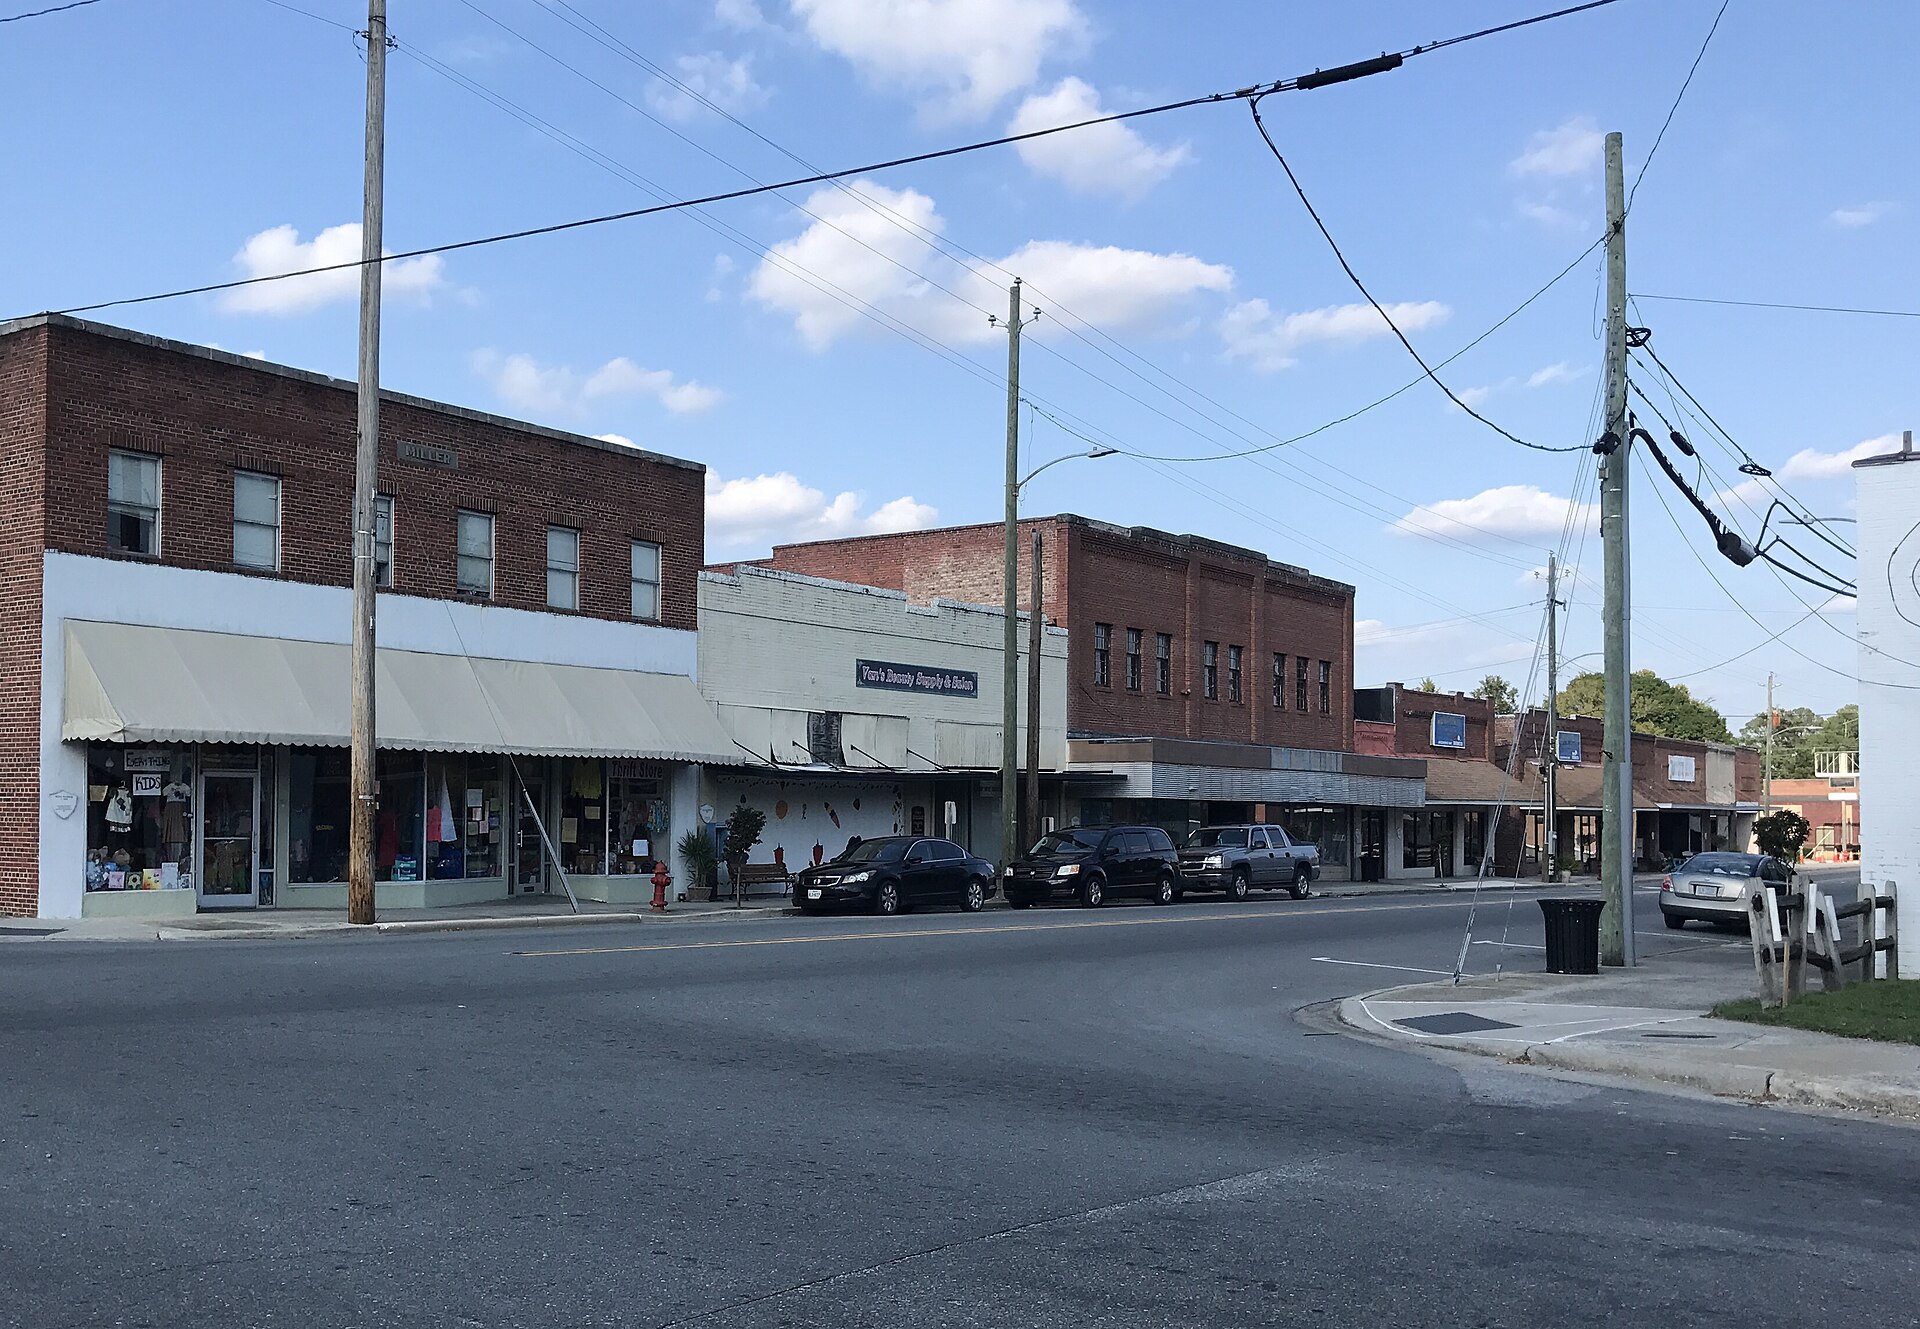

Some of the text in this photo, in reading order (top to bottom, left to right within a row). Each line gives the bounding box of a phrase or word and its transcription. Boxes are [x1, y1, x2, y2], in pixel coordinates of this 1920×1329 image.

[405, 445, 451, 464] MILLER
[862, 665, 974, 691] Van's Beauty Supply & Salon
[611, 760, 663, 778] Thrift Store
[135, 776, 161, 791] KIDS
